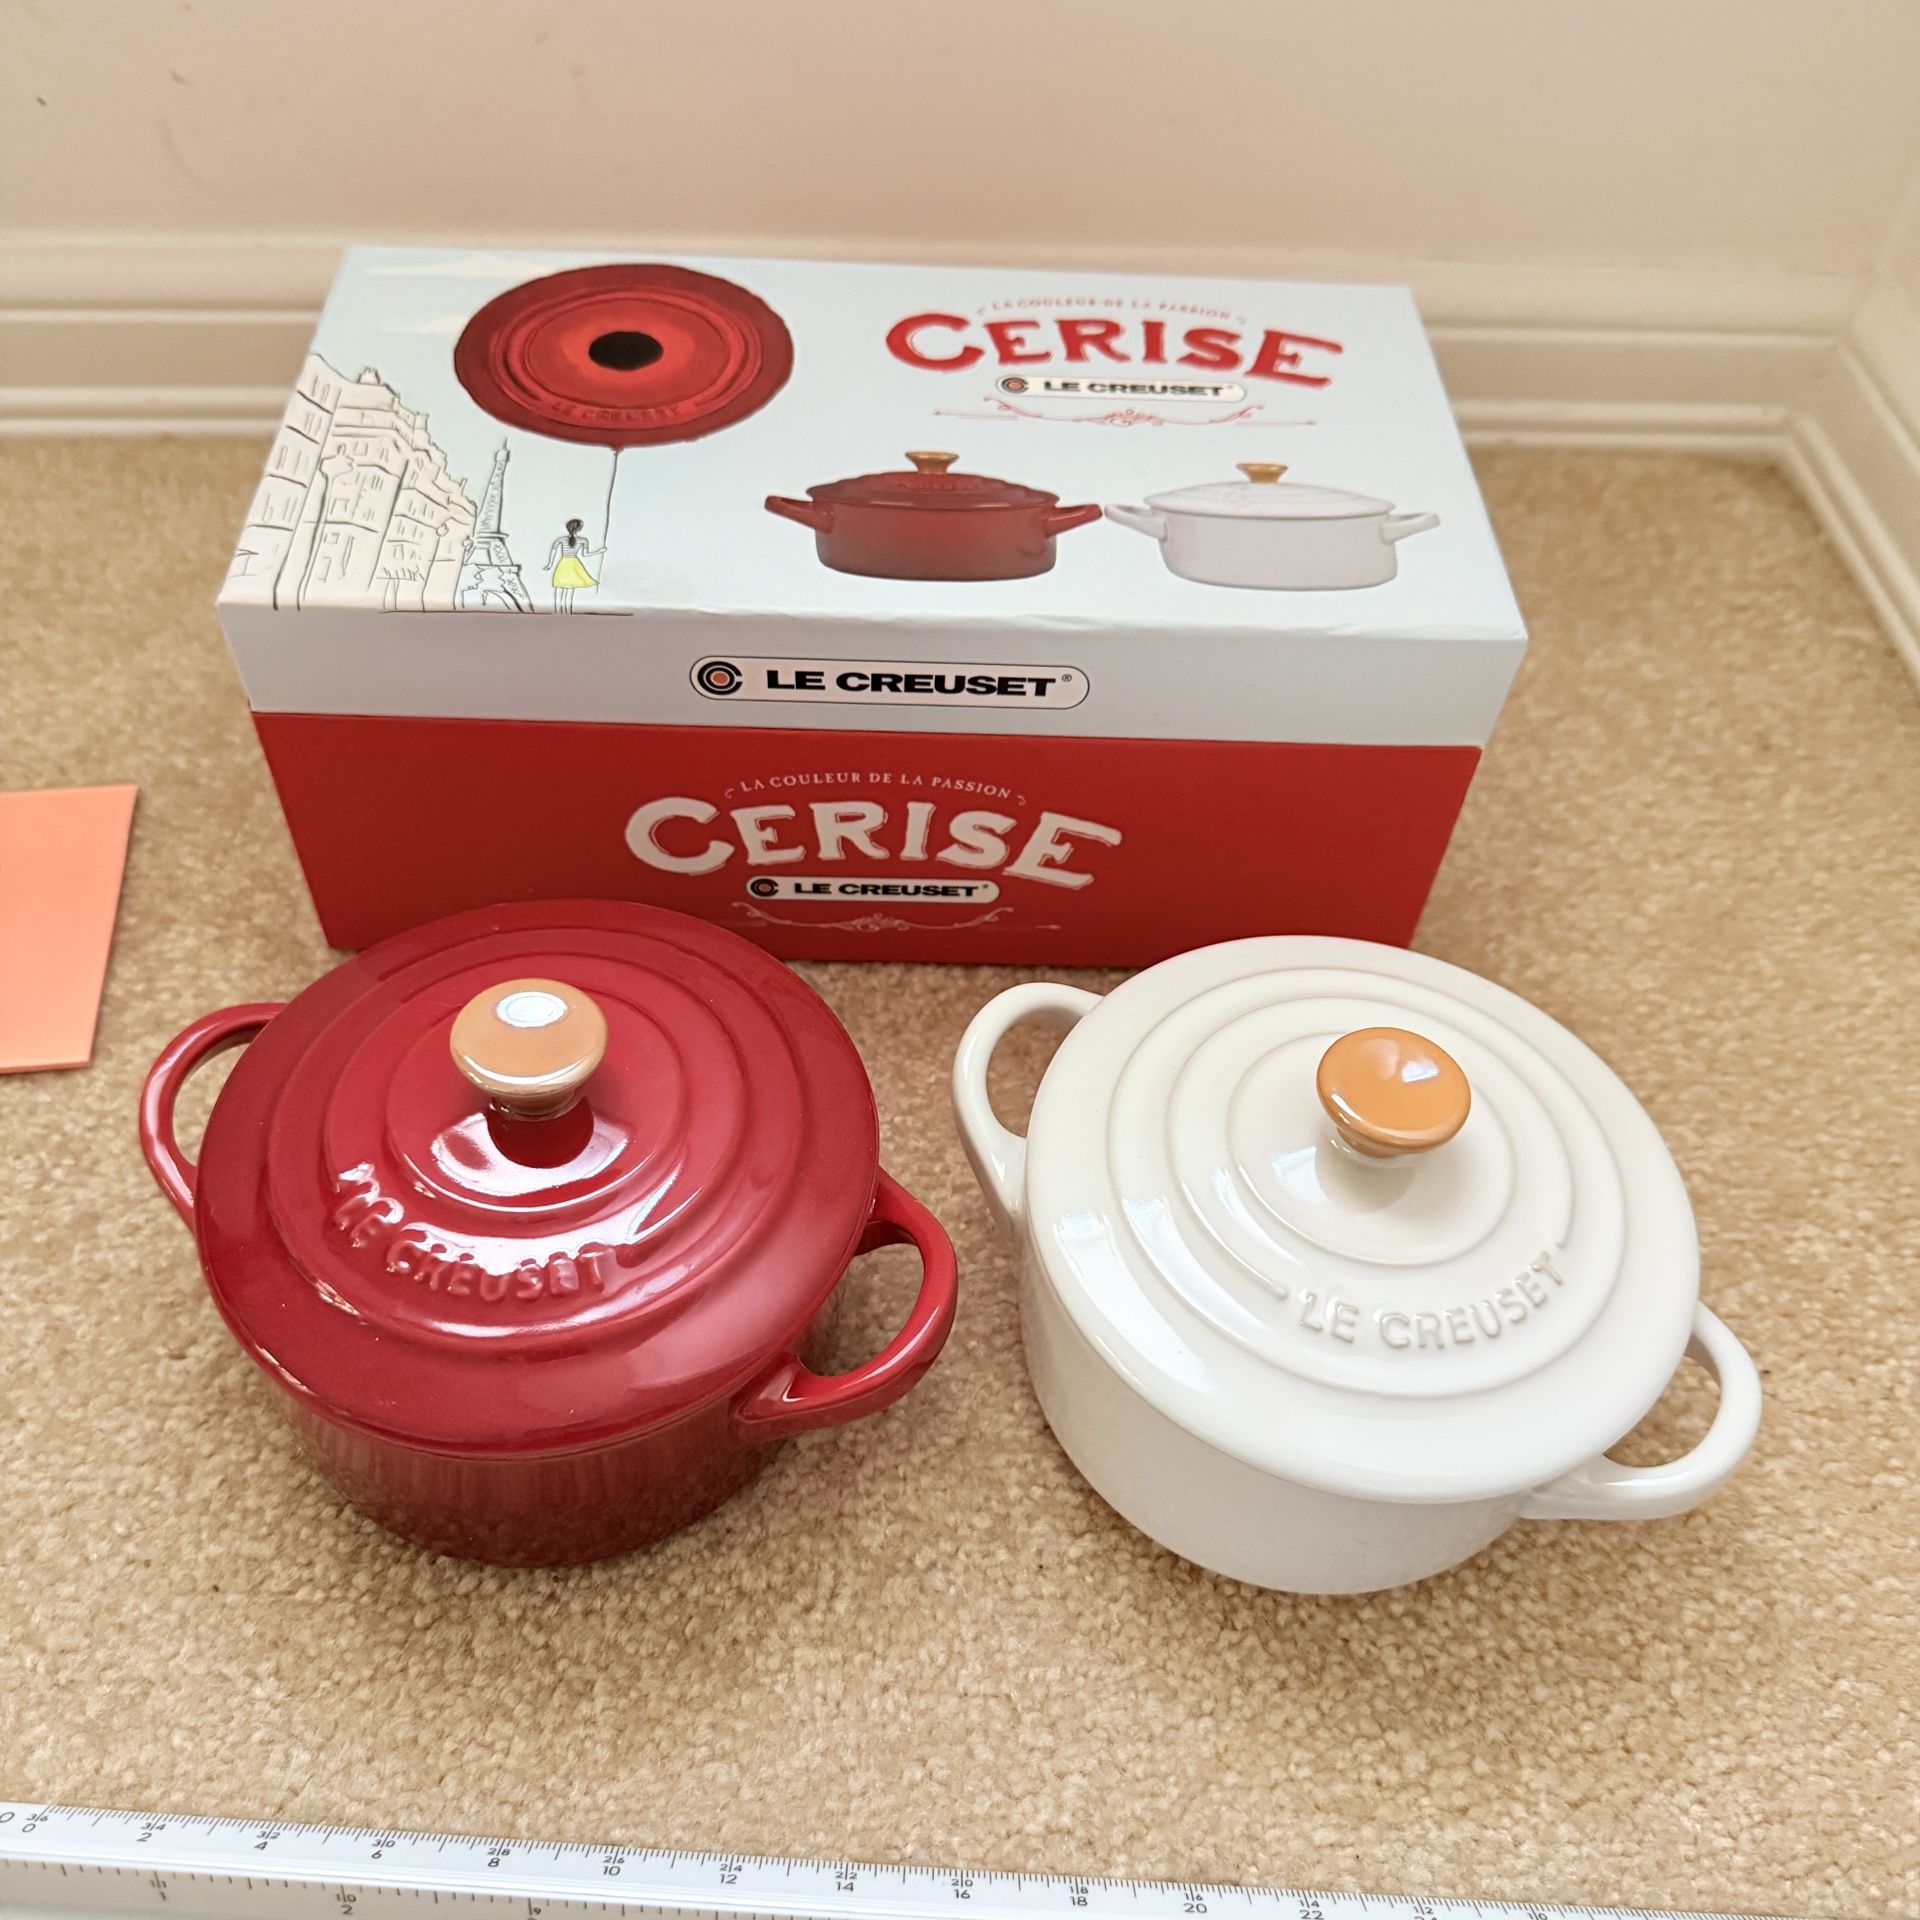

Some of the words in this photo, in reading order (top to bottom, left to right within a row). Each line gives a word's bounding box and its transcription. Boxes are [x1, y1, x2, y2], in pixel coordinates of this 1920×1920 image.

[886, 312, 1344, 391] CERISE
[1043, 380, 1081, 392] LE
[1087, 382, 1224, 397] CREUSET
[766, 669, 826, 691] LE
[835, 672, 1056, 697] CREUSET
[740, 778, 765, 793] LA
[769, 771, 861, 788] COULEUR
[869, 772, 893, 784] DE
[901, 773, 923, 786] LA
[931, 776, 1012, 799] PASSION
[624, 796, 1123, 891] CERISE
[794, 882, 832, 894] LE
[838, 883, 979, 897] CREUSET
[1299, 1291, 1360, 1344] LE
[1379, 1250, 1563, 1349] CREUSET
[22, 1823, 36, 1833] 0
[136, 1832, 152, 1842] 2
[254, 1841, 268, 1851] 4
[371, 1850, 382, 1859] 6
[487, 1857, 500, 1868] 8
[602, 1866, 621, 1876] 10
[719, 1873, 737, 1884] 12
[835, 1882, 854, 1891] 14
[953, 1889, 971, 1899] 16
[1070, 1896, 1088, 1907] 18
[1183, 1903, 1207, 1914] 20
[1300, 1910, 1324, 1920] 22
[341, 1904, 353, 1915] 2
